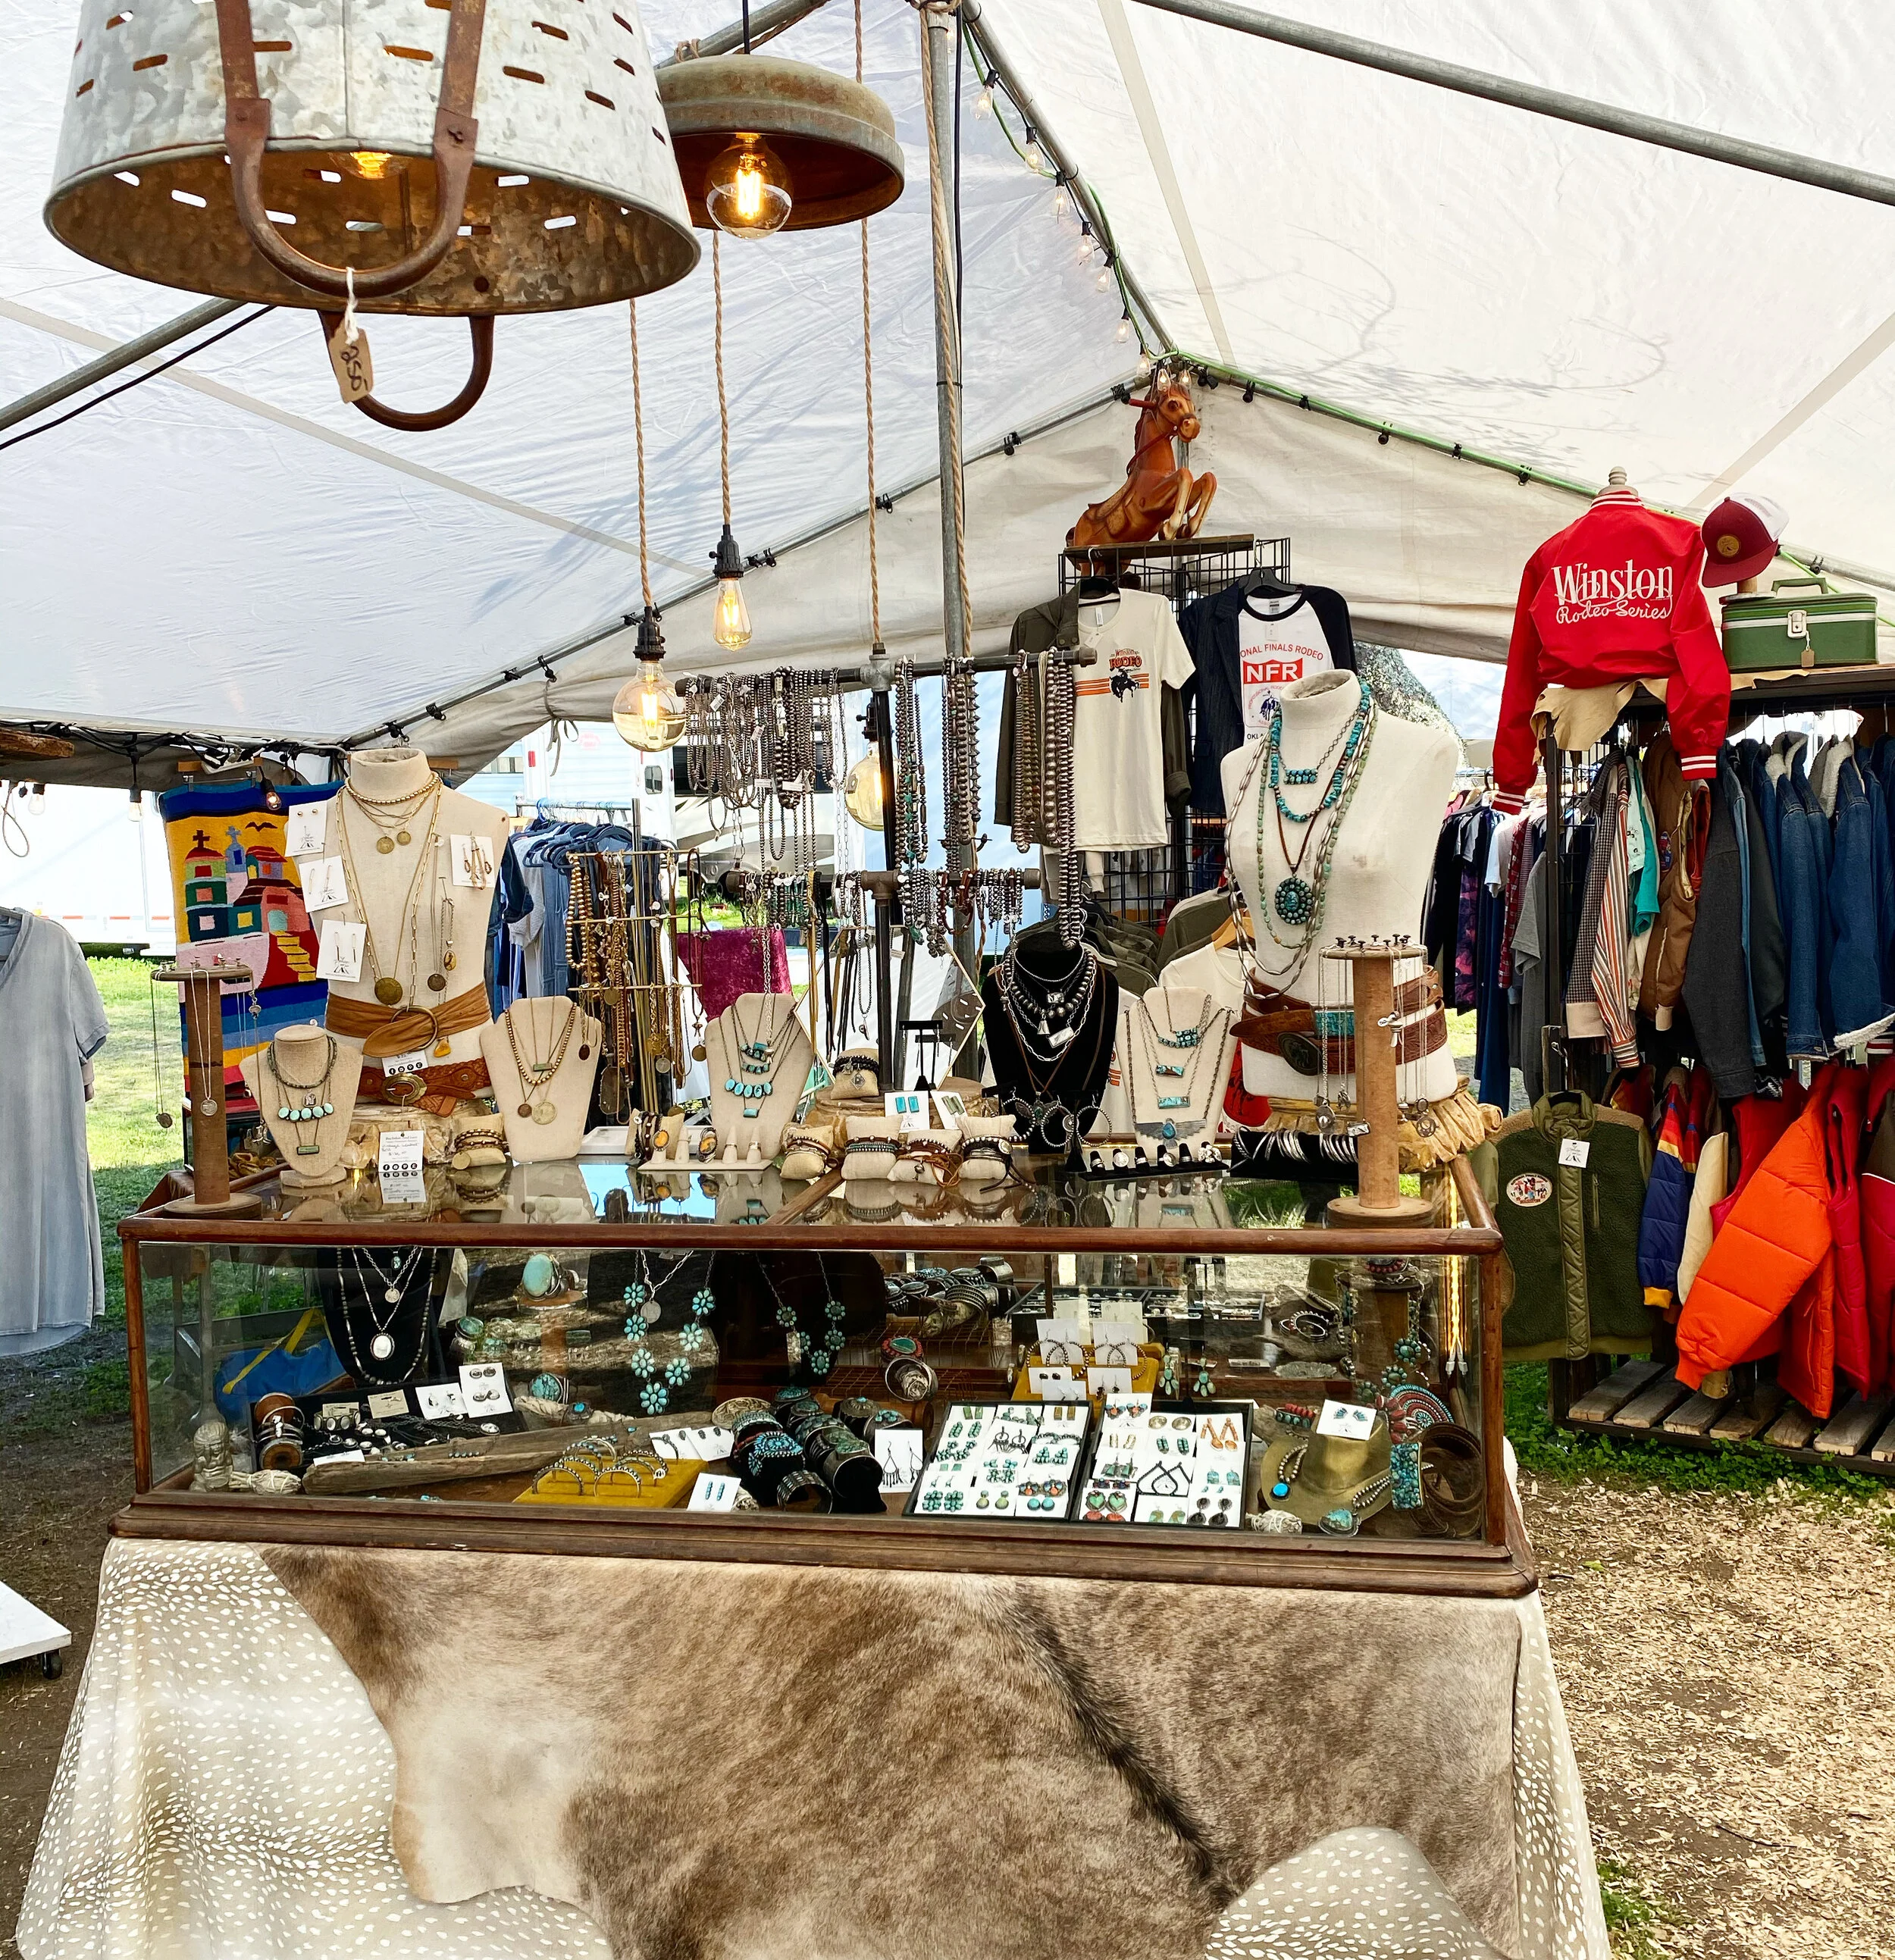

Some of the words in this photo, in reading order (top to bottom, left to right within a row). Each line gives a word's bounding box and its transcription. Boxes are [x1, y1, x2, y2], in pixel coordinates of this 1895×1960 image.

[1551, 559, 1673, 606] Winston
[1555, 601, 1610, 624] Rodeo
[1615, 600, 1668, 620] Series
[1240, 645, 1262, 658] ONAL
[1264, 643, 1293, 653] FINALS
[1295, 645, 1323, 661] RODEO
[1247, 662, 1298, 683] NFR
